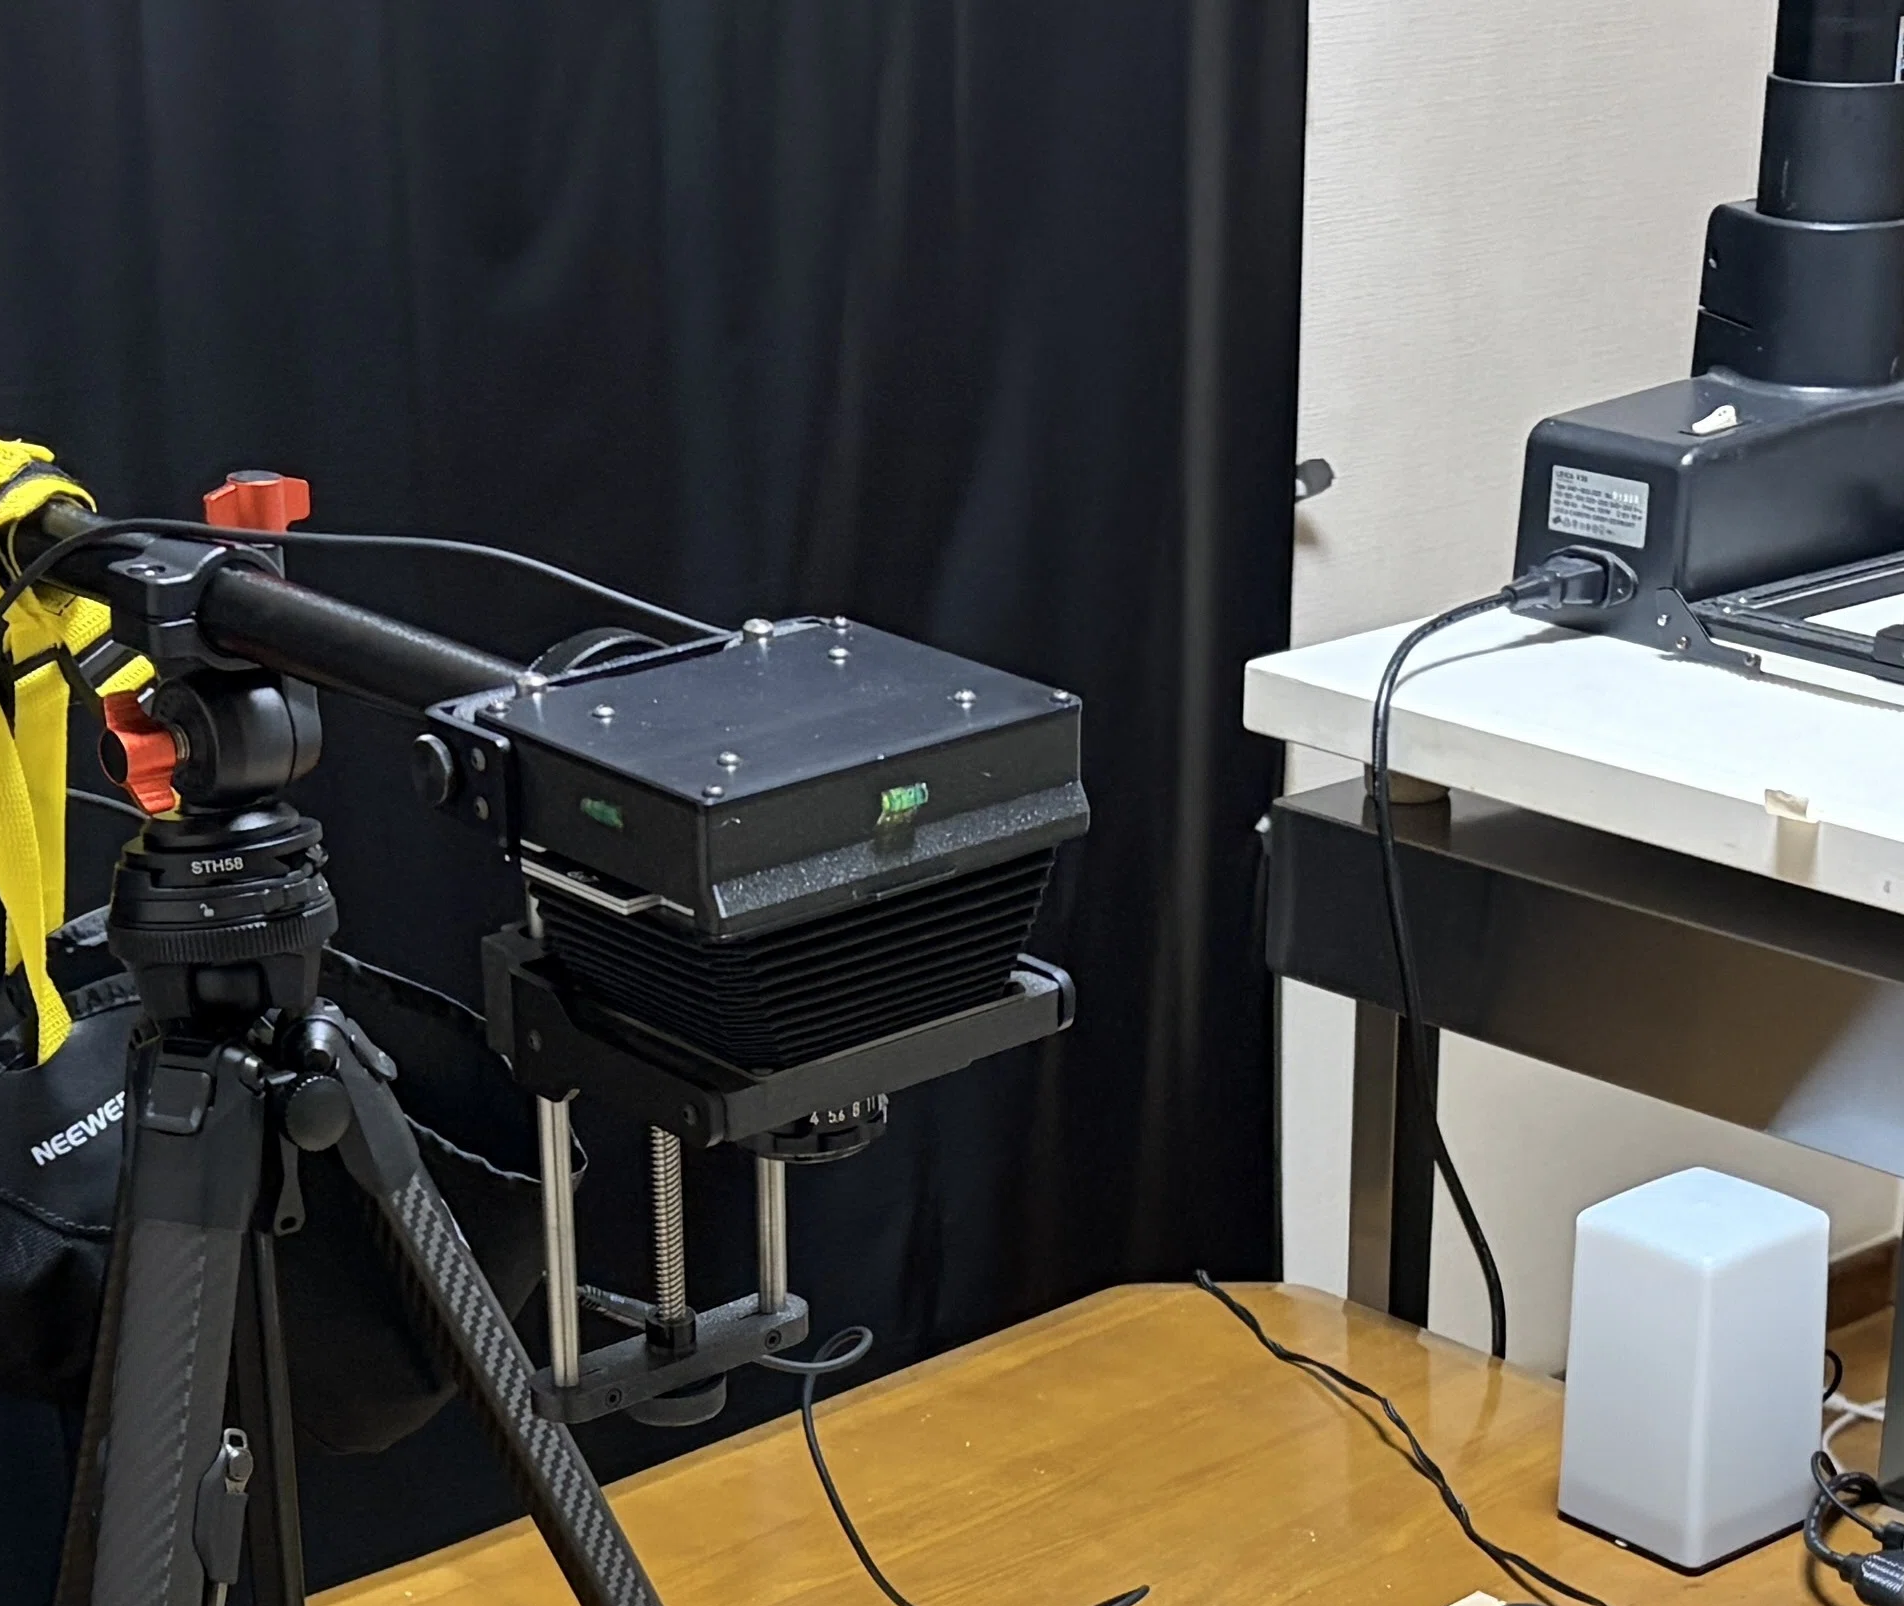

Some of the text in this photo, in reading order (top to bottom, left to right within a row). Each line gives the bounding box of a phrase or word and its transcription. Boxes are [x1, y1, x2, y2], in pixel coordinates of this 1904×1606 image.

[191, 856, 244, 875] STH58
[809, 1111, 820, 1126] 4
[852, 1101, 861, 1118] 8
